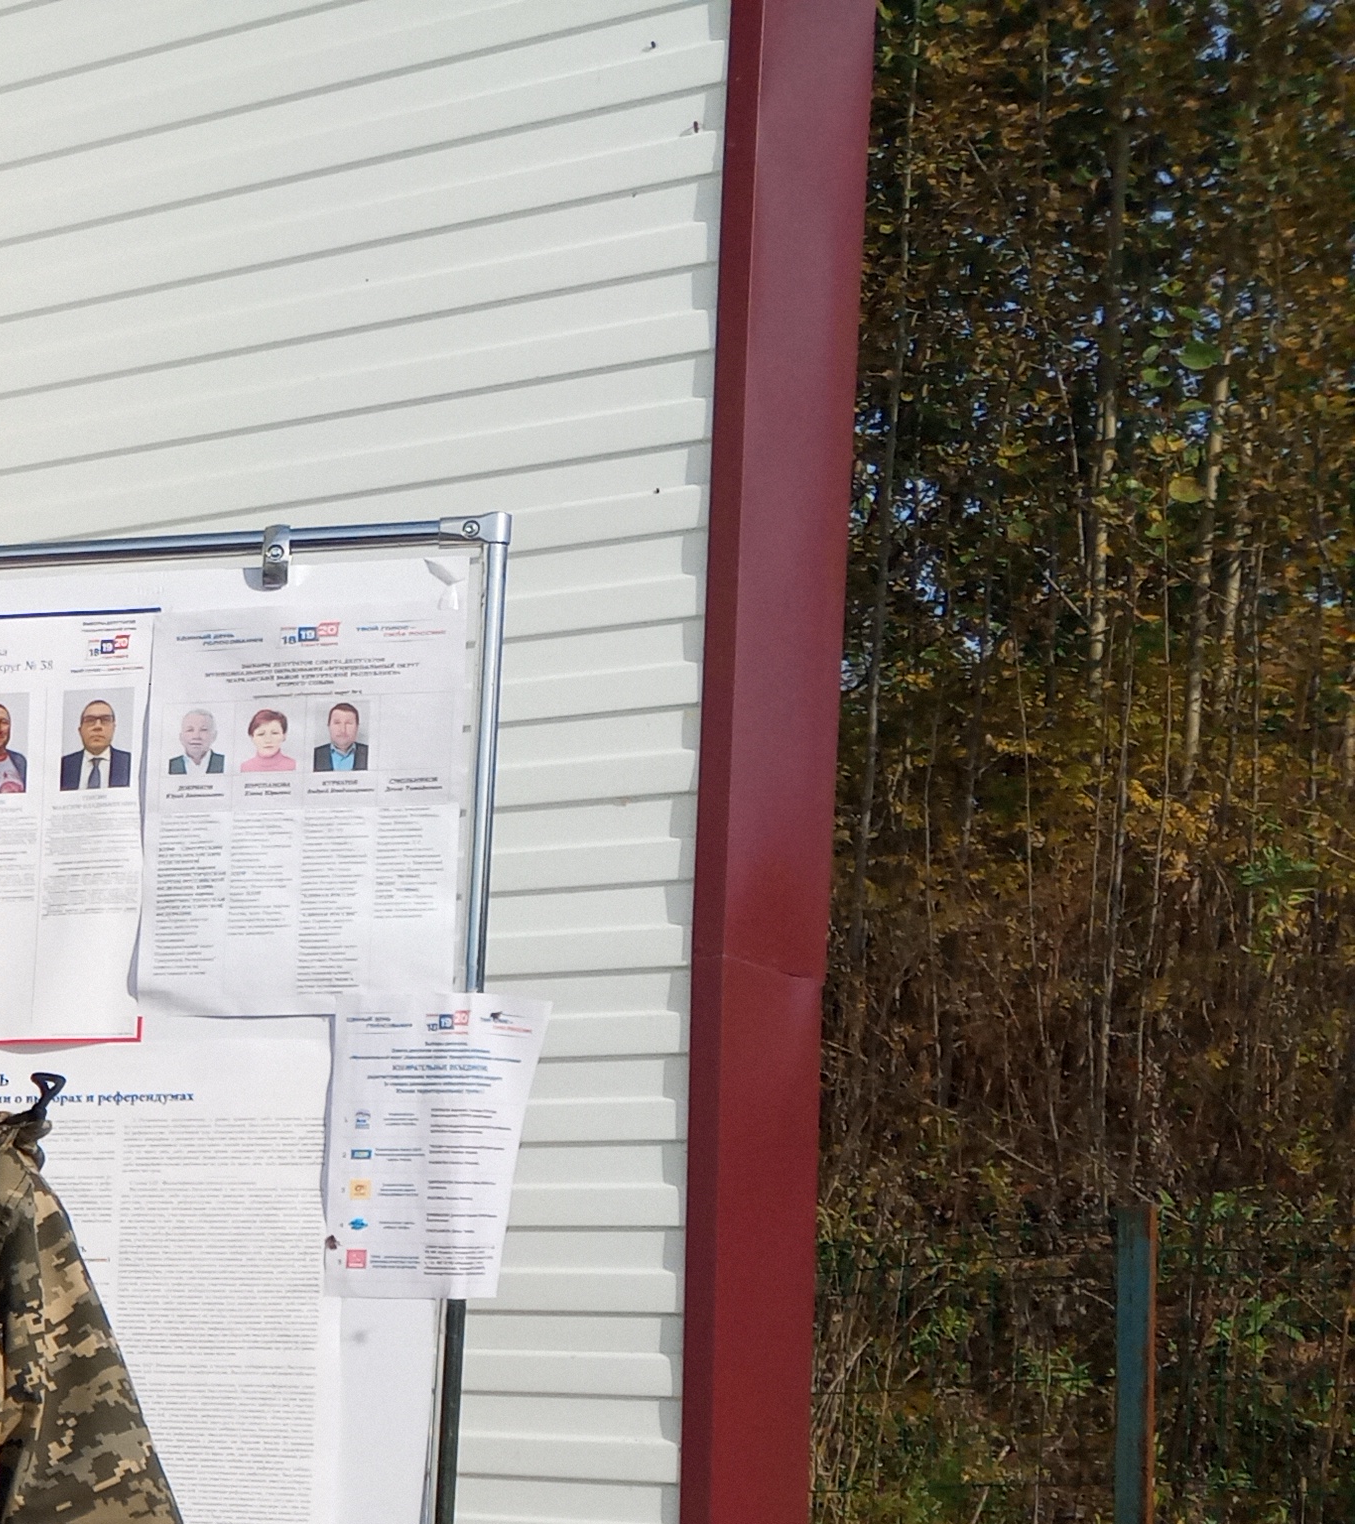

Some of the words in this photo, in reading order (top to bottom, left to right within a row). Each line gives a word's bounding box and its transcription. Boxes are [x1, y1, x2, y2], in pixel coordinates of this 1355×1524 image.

[15, 1096, 22, 1104] о
[26, 1093, 83, 1107] выорах
[98, 1091, 194, 1107] референдумах
